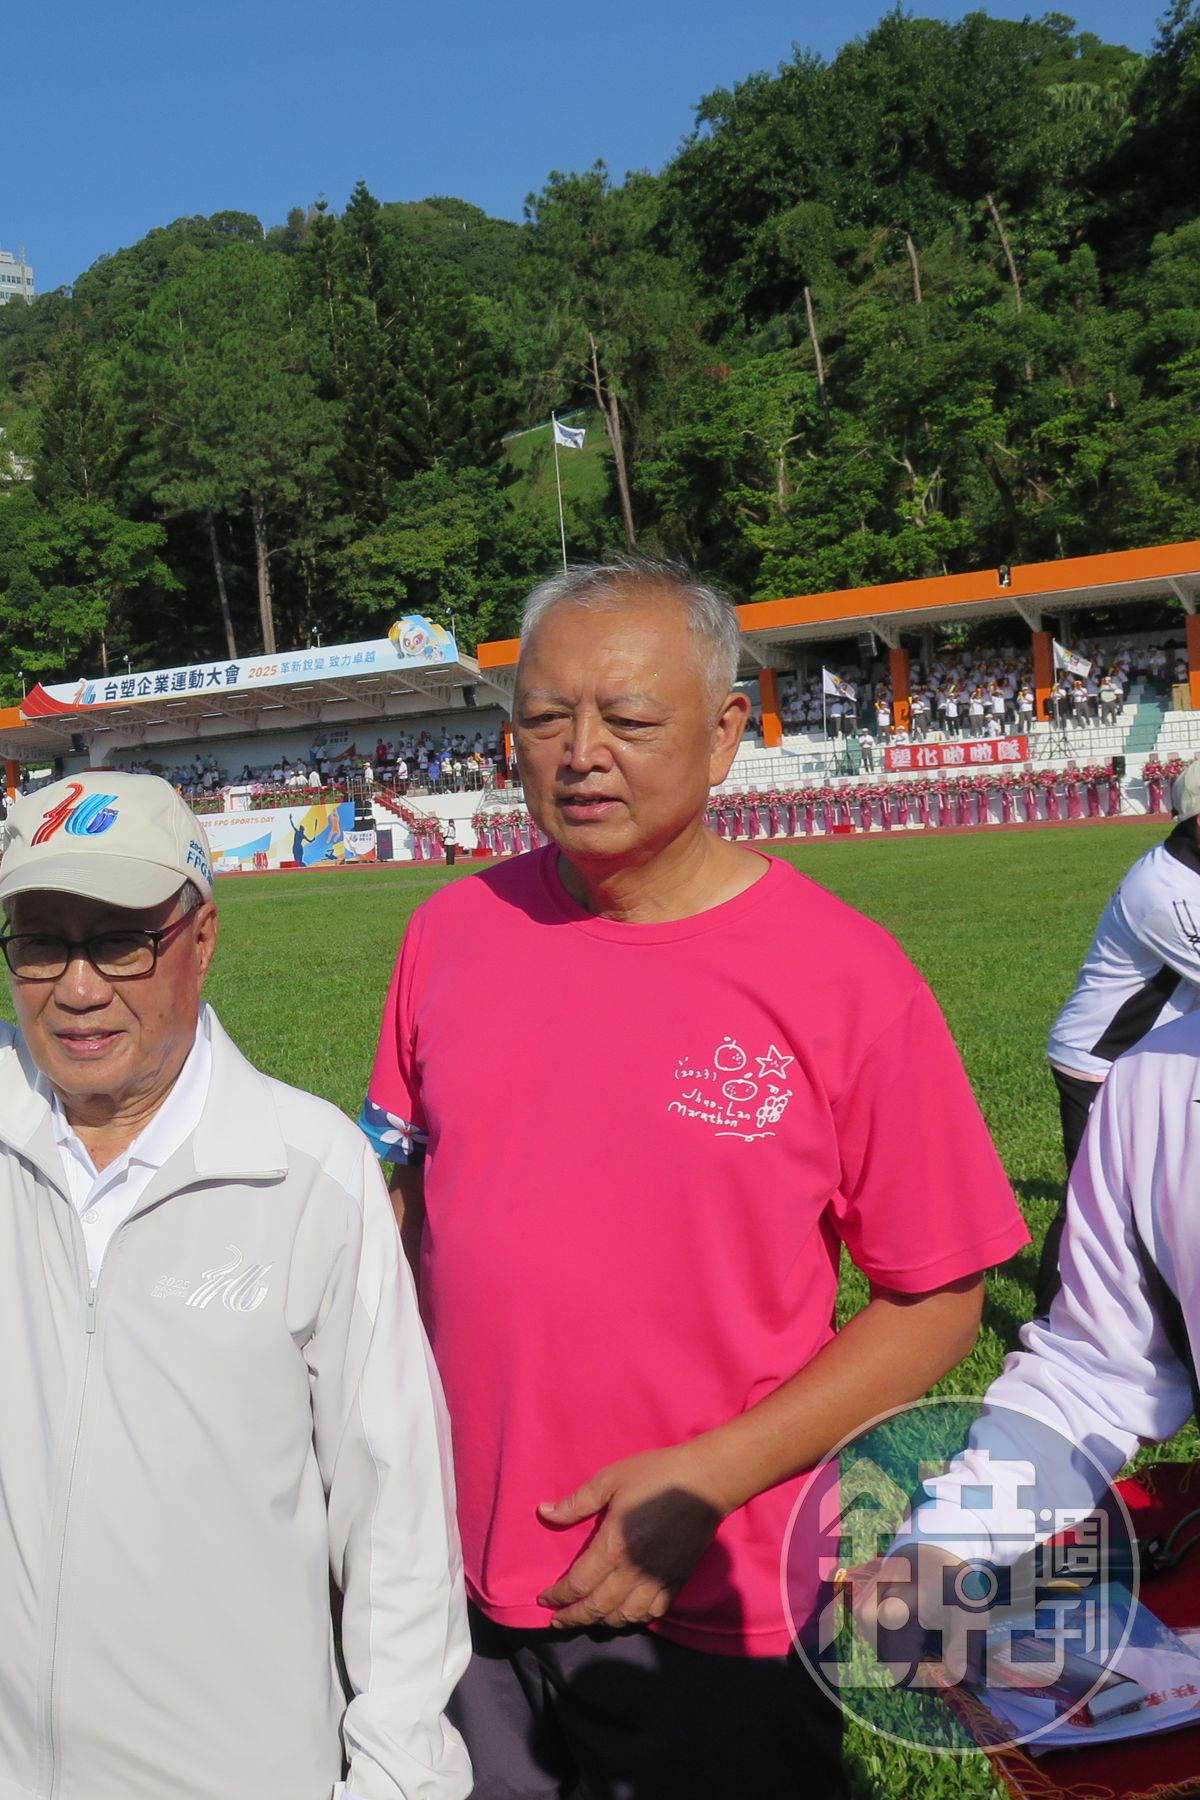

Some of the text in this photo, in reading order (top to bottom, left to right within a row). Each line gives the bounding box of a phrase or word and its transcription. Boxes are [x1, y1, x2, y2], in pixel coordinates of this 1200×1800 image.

[248, 665, 278, 679] 2025
[329, 650, 377, 668] 致力卓越
[104, 664, 240, 701] 台塑企業運動大會
[230, 816, 260, 826] SPORTS
[260, 815, 275, 823] DAY
[157, 1274, 191, 1290] 2025
